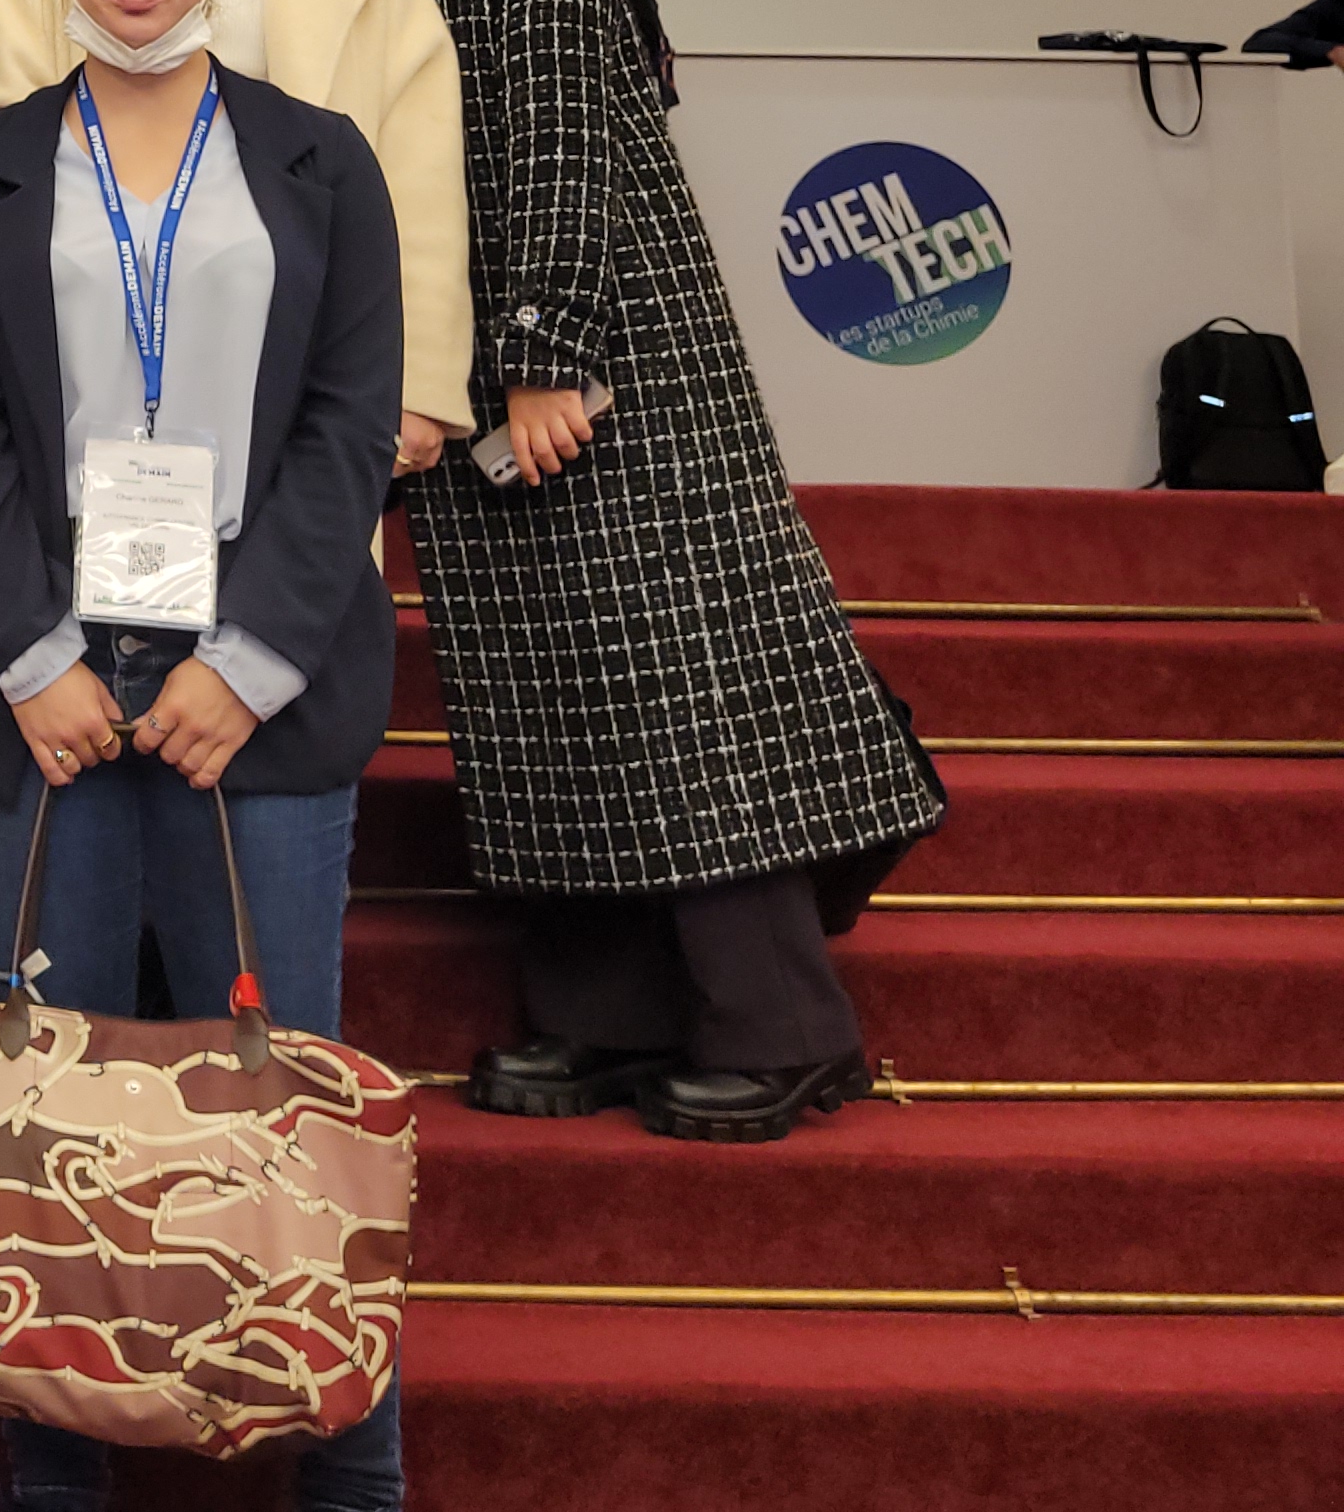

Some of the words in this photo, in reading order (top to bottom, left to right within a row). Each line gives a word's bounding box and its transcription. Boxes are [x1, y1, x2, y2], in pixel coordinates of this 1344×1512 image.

[776, 172, 926, 277] CHEM
[867, 203, 1011, 303] TECH
[865, 296, 944, 338] startups
[867, 336, 891, 356] de
[891, 328, 912, 347] la
[913, 303, 979, 338] Chimie
